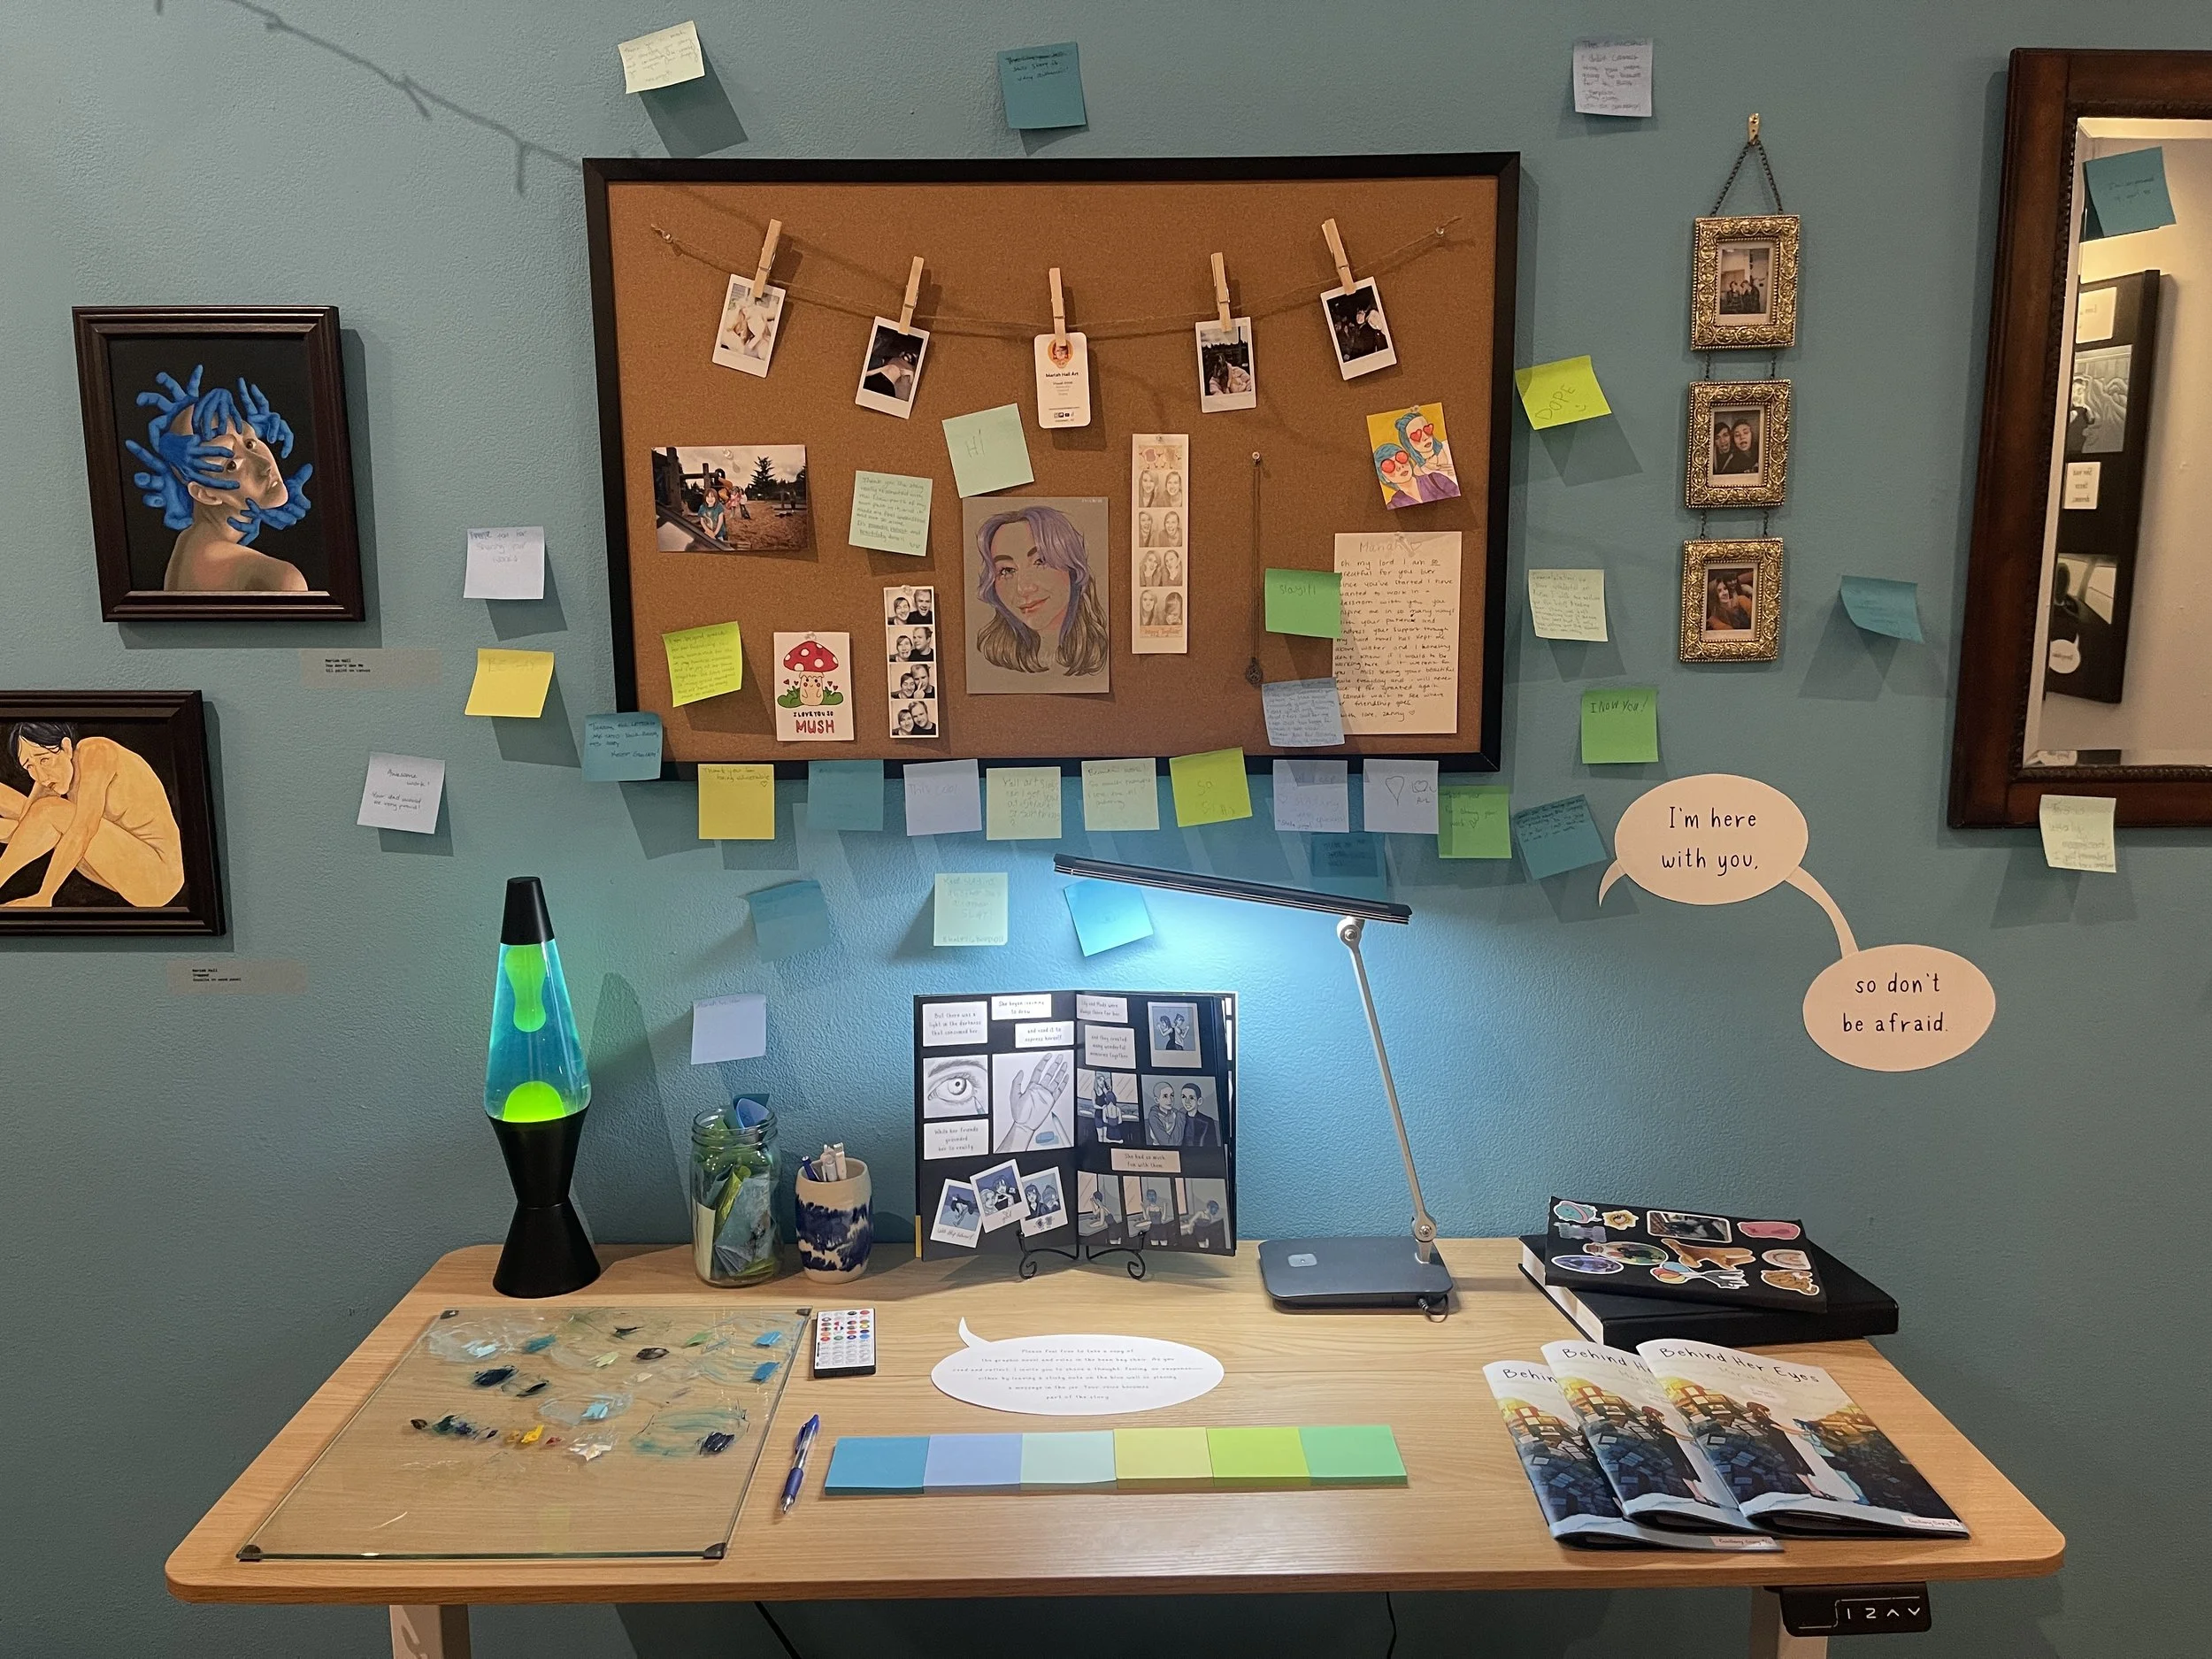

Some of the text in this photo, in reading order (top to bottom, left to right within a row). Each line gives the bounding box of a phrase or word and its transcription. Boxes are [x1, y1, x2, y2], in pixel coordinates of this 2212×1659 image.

[1534, 383, 1576, 420] DOPE
[1357, 560, 1371, 571] my
[1398, 570, 1412, 580] you
[1409, 609, 1432, 618] many
[795, 719, 835, 734] MUSH
[388, 768, 418, 779] Awesome
[1669, 806, 1756, 829] I'm here
[1662, 847, 1706, 869] with
[1855, 972, 1940, 993] so don't
[1843, 1012, 1948, 1033] be afraid.
[945, 1134, 968, 1144] grounded
[1562, 1348, 1628, 1366] Behind
[1659, 1347, 1820, 1384] Behind Her Eyes
[1502, 1368, 1558, 1384] Behin
[1865, 1607, 1877, 1619] 2
